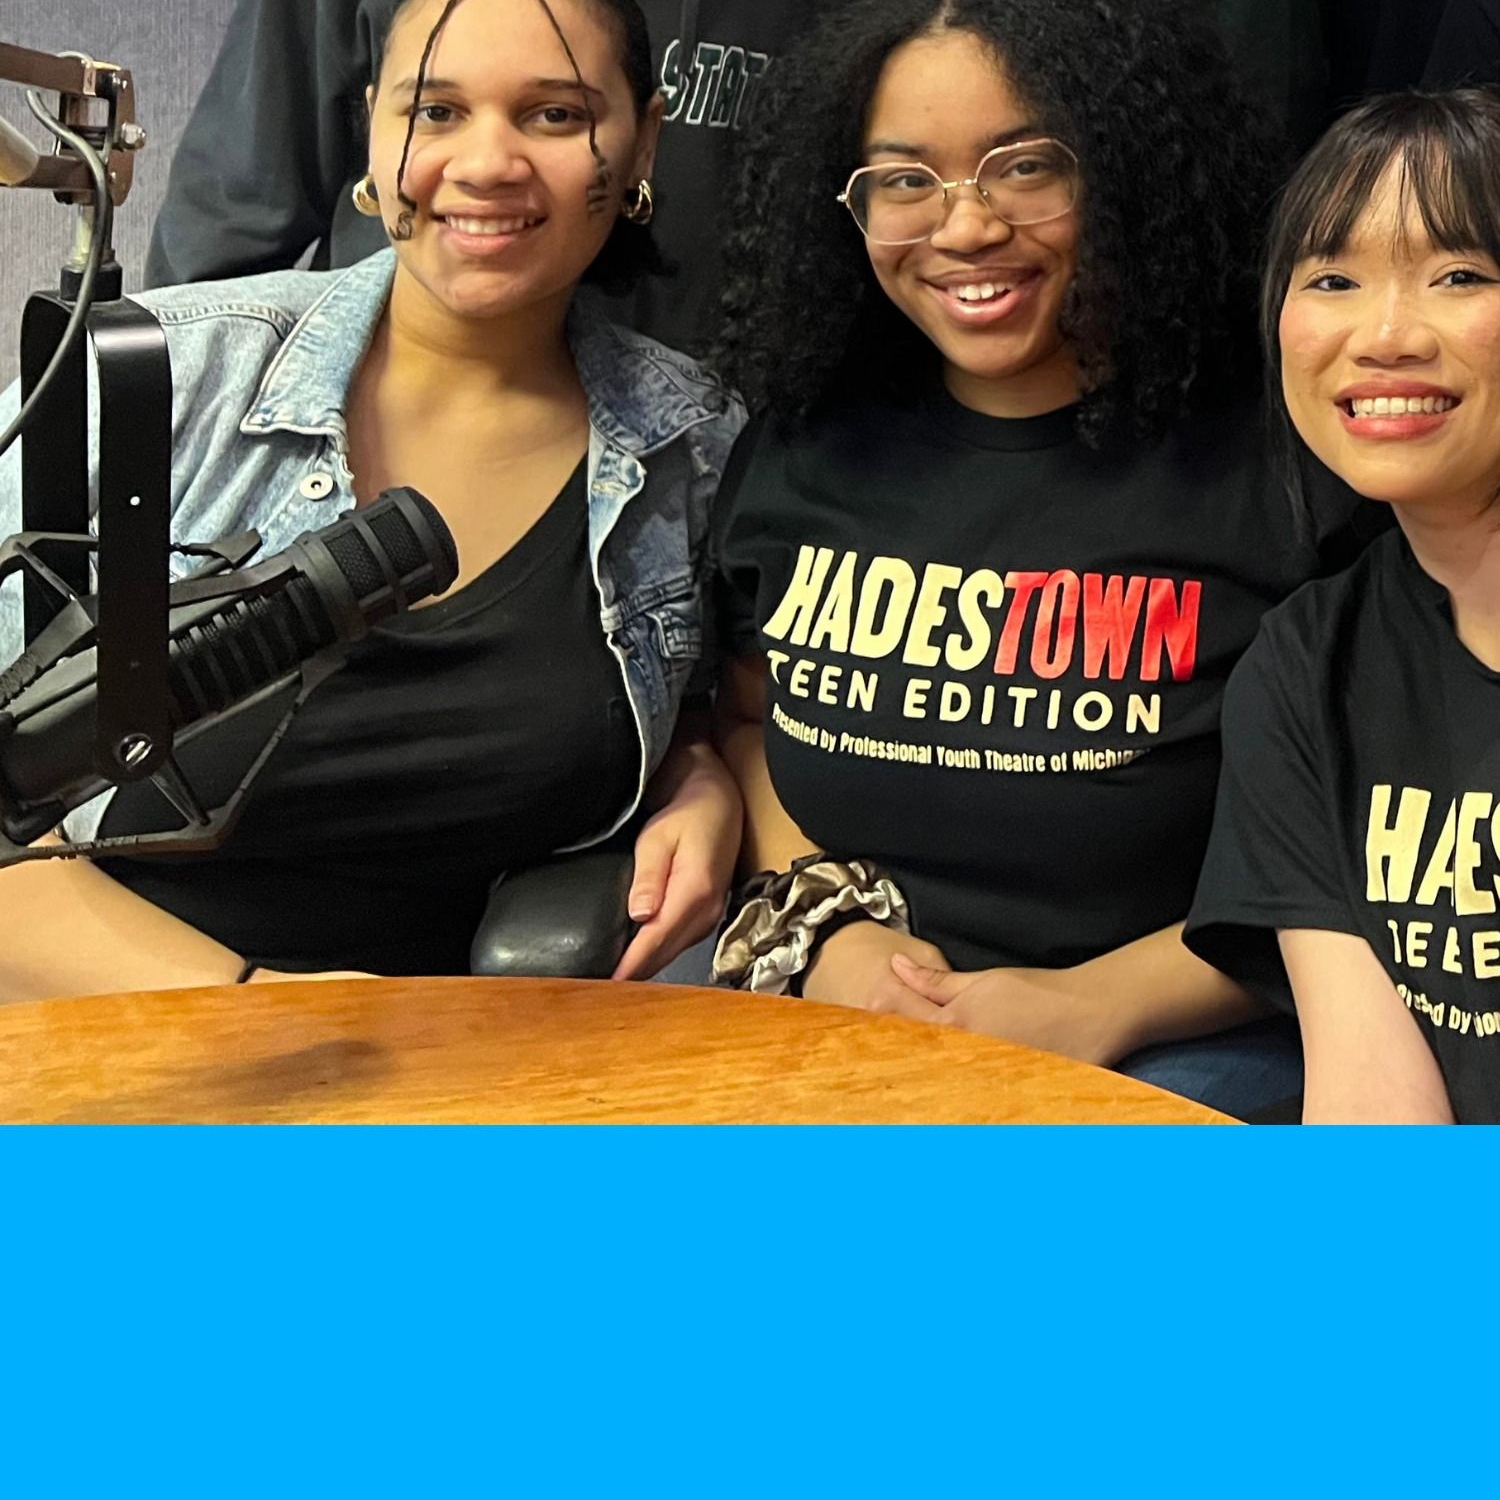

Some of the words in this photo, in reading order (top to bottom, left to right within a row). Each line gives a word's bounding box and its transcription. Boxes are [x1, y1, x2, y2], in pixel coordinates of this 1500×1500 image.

[762, 545, 1202, 682] HADESTOWN
[766, 650, 879, 711] TEEN
[903, 678, 1161, 734] EDITION
[772, 702, 818, 747] Presented
[820, 729, 837, 753] by
[840, 733, 931, 764] Professional
[937, 746, 980, 771] Youth
[985, 750, 1045, 772] Theatre
[1050, 752, 1067, 772] of
[1448, 1004, 1472, 1035] by
